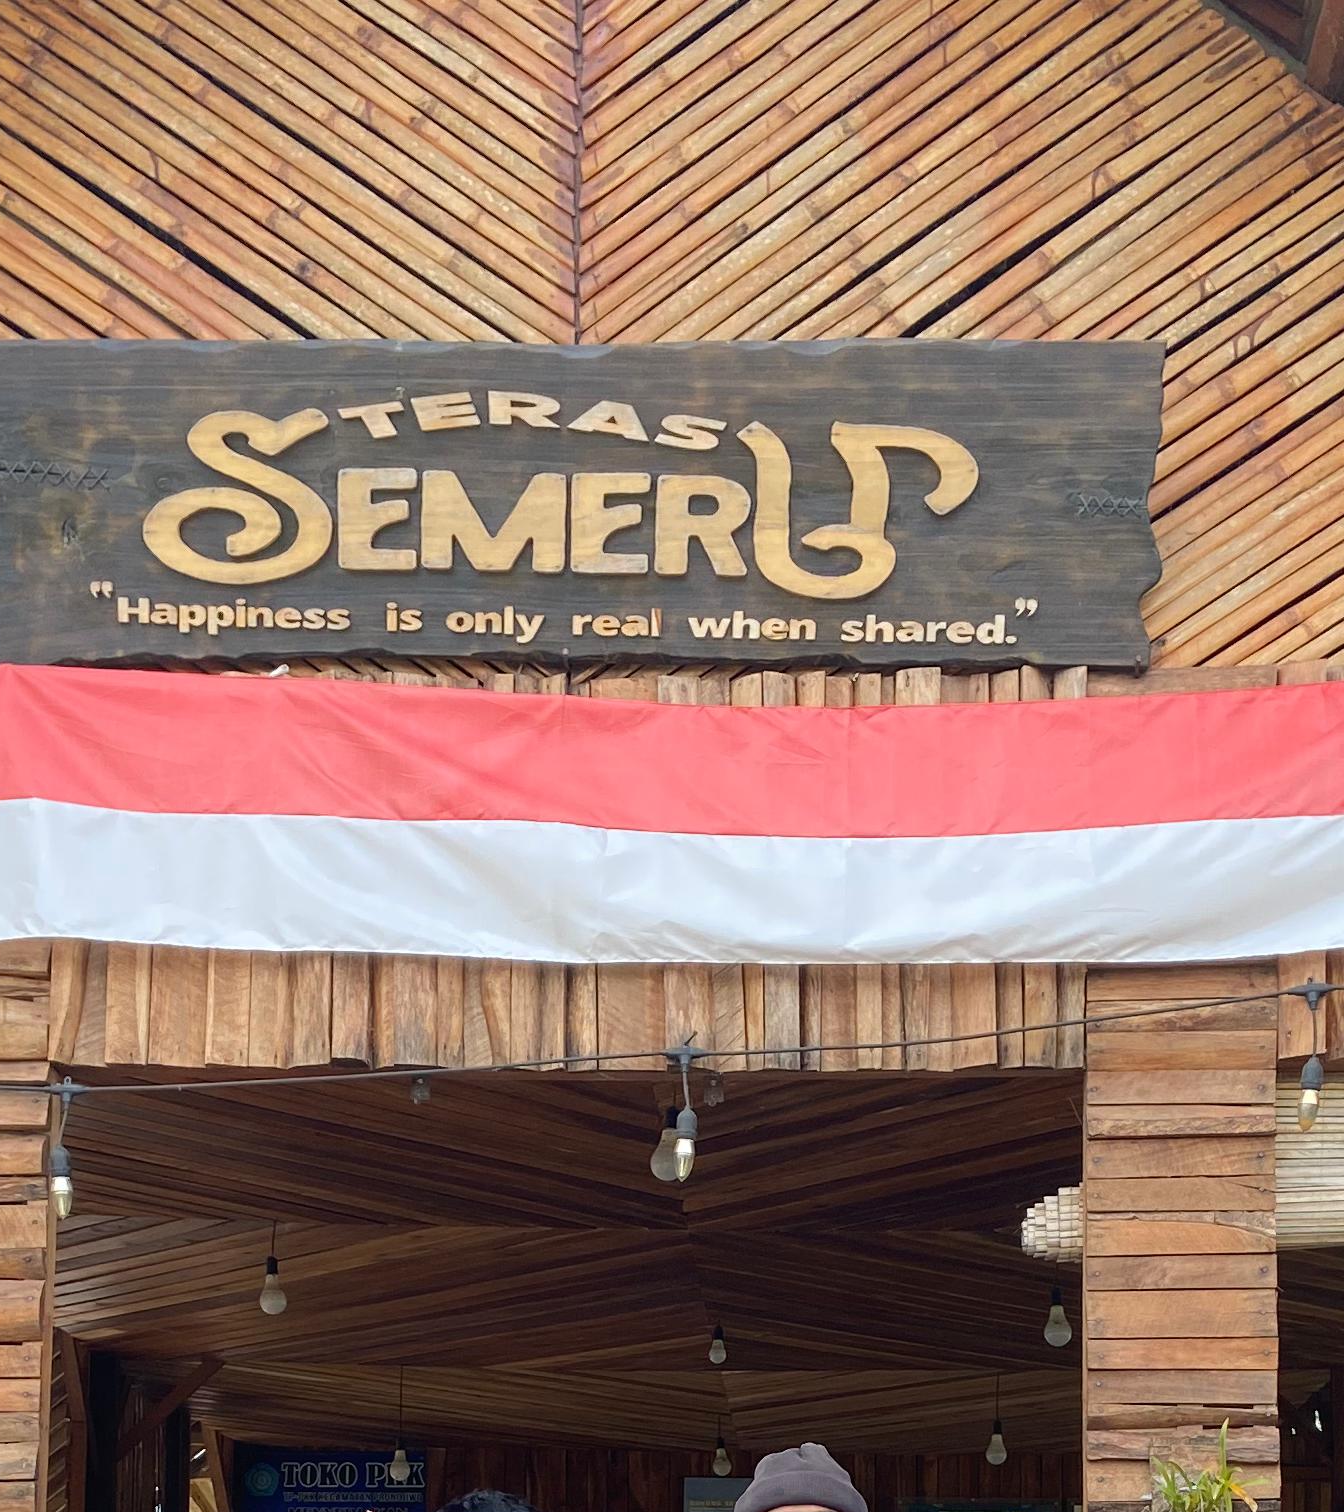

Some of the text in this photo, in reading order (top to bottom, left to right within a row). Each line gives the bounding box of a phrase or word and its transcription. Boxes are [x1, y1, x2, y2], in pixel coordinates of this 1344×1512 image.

[338, 390, 728, 450] TERAS
[142, 407, 979, 599] SEMERU
[386, 601, 423, 632] is
[445, 605, 545, 644] only
[572, 607, 662, 637] real
[687, 610, 817, 640] when
[281, 1461, 358, 1488] TOKO
